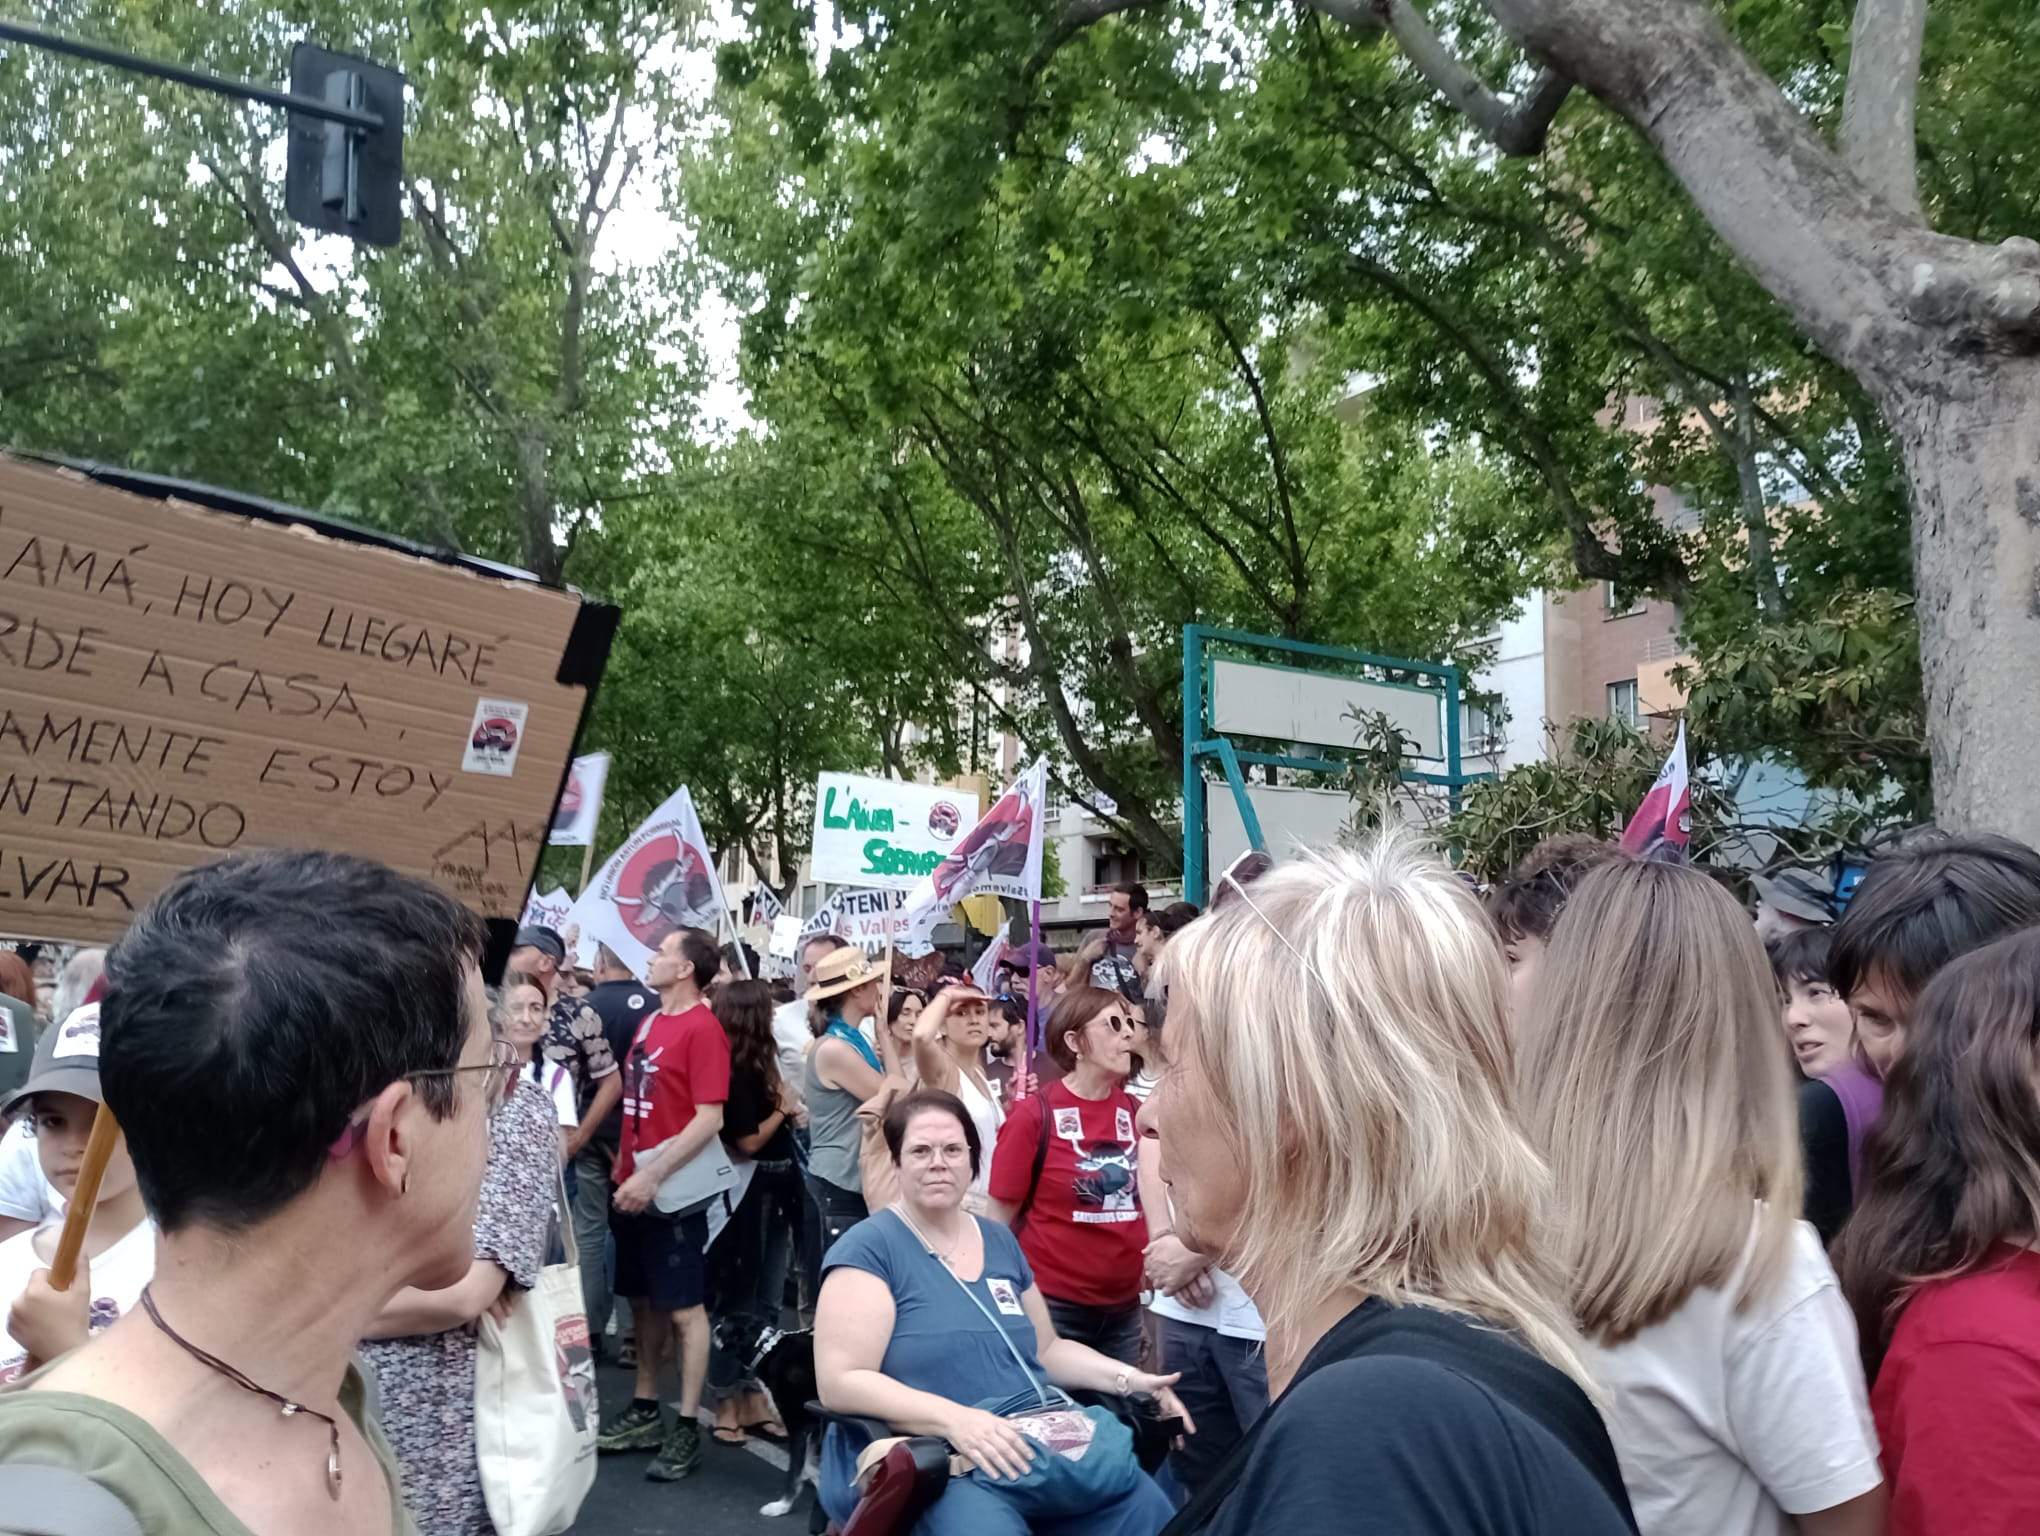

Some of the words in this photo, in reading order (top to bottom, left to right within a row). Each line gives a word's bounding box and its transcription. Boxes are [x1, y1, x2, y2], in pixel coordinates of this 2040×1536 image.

[0, 506, 152, 617] AMÁ,
[173, 575, 296, 638] HOY
[316, 606, 511, 687] LLEGARÉ
[139, 649, 175, 695] A
[259, 749, 454, 813] ESTOY
